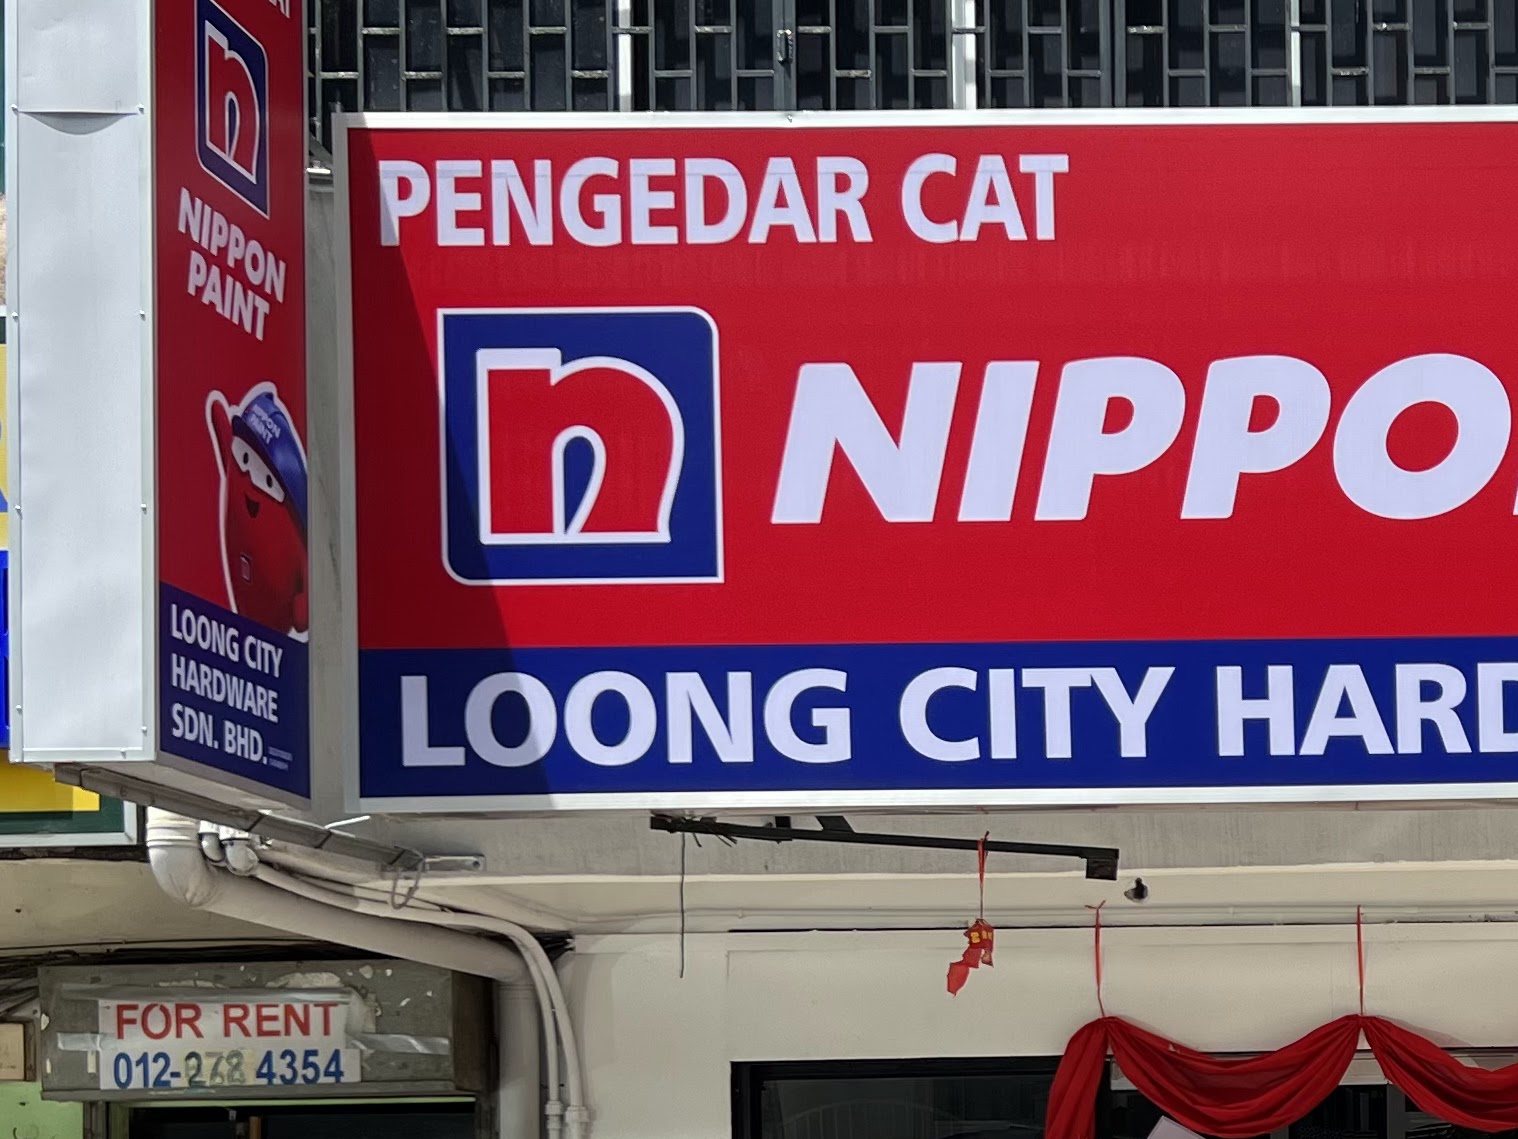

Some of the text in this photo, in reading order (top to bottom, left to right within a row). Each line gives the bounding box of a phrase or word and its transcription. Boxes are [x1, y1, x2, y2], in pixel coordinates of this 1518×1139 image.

[379, 153, 1069, 247] PENGEDAR CAT
[178, 187, 286, 303] NIPPON
[187, 250, 270, 341] PAINT
[172, 603, 283, 678] LOONG CITY
[171, 653, 278, 723] HARDWARE
[401, 668, 851, 767] LOONG
[899, 666, 1174, 762] CITY
[172, 703, 219, 749] SDN.
[224, 719, 267, 765] BHD.
[116, 1003, 338, 1040] FOR RENT
[256, 1048, 344, 1086] 4354
